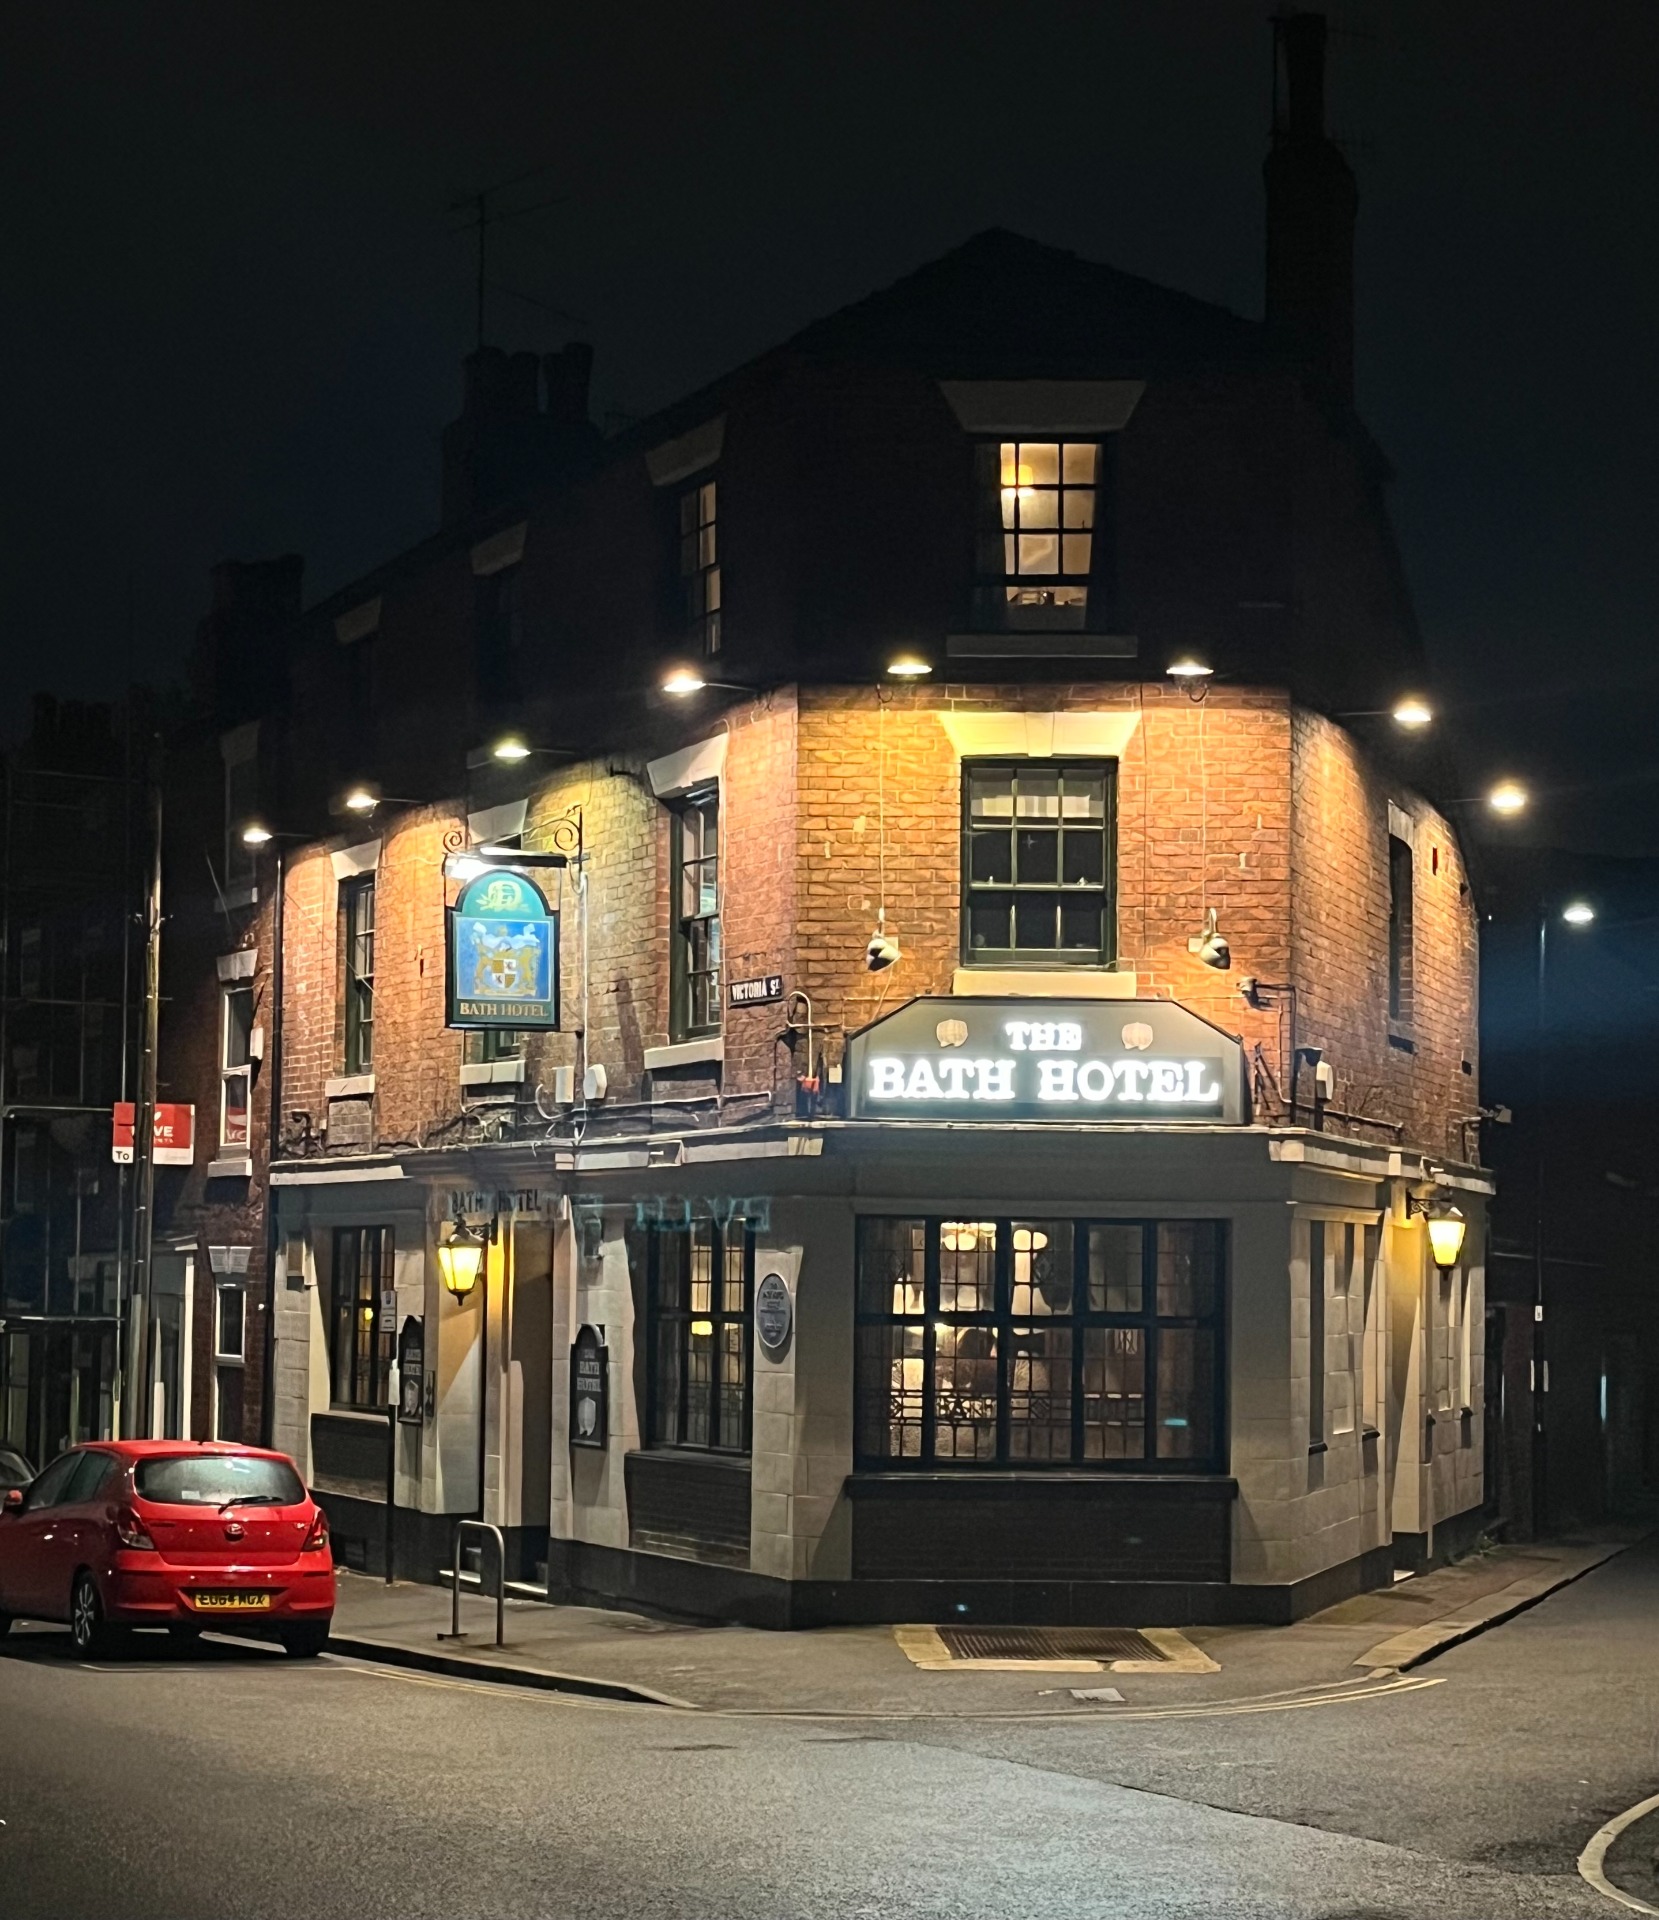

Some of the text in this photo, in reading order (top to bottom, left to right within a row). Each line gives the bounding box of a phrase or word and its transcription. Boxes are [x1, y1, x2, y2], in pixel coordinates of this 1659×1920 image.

[732, 979, 767, 1001] VICTORIA
[459, 1002, 548, 1017] BATH HOTEL
[1005, 1021, 1082, 1050] THE
[868, 1058, 1220, 1102] BATH HOTEL
[452, 1190, 483, 1213] BATH
